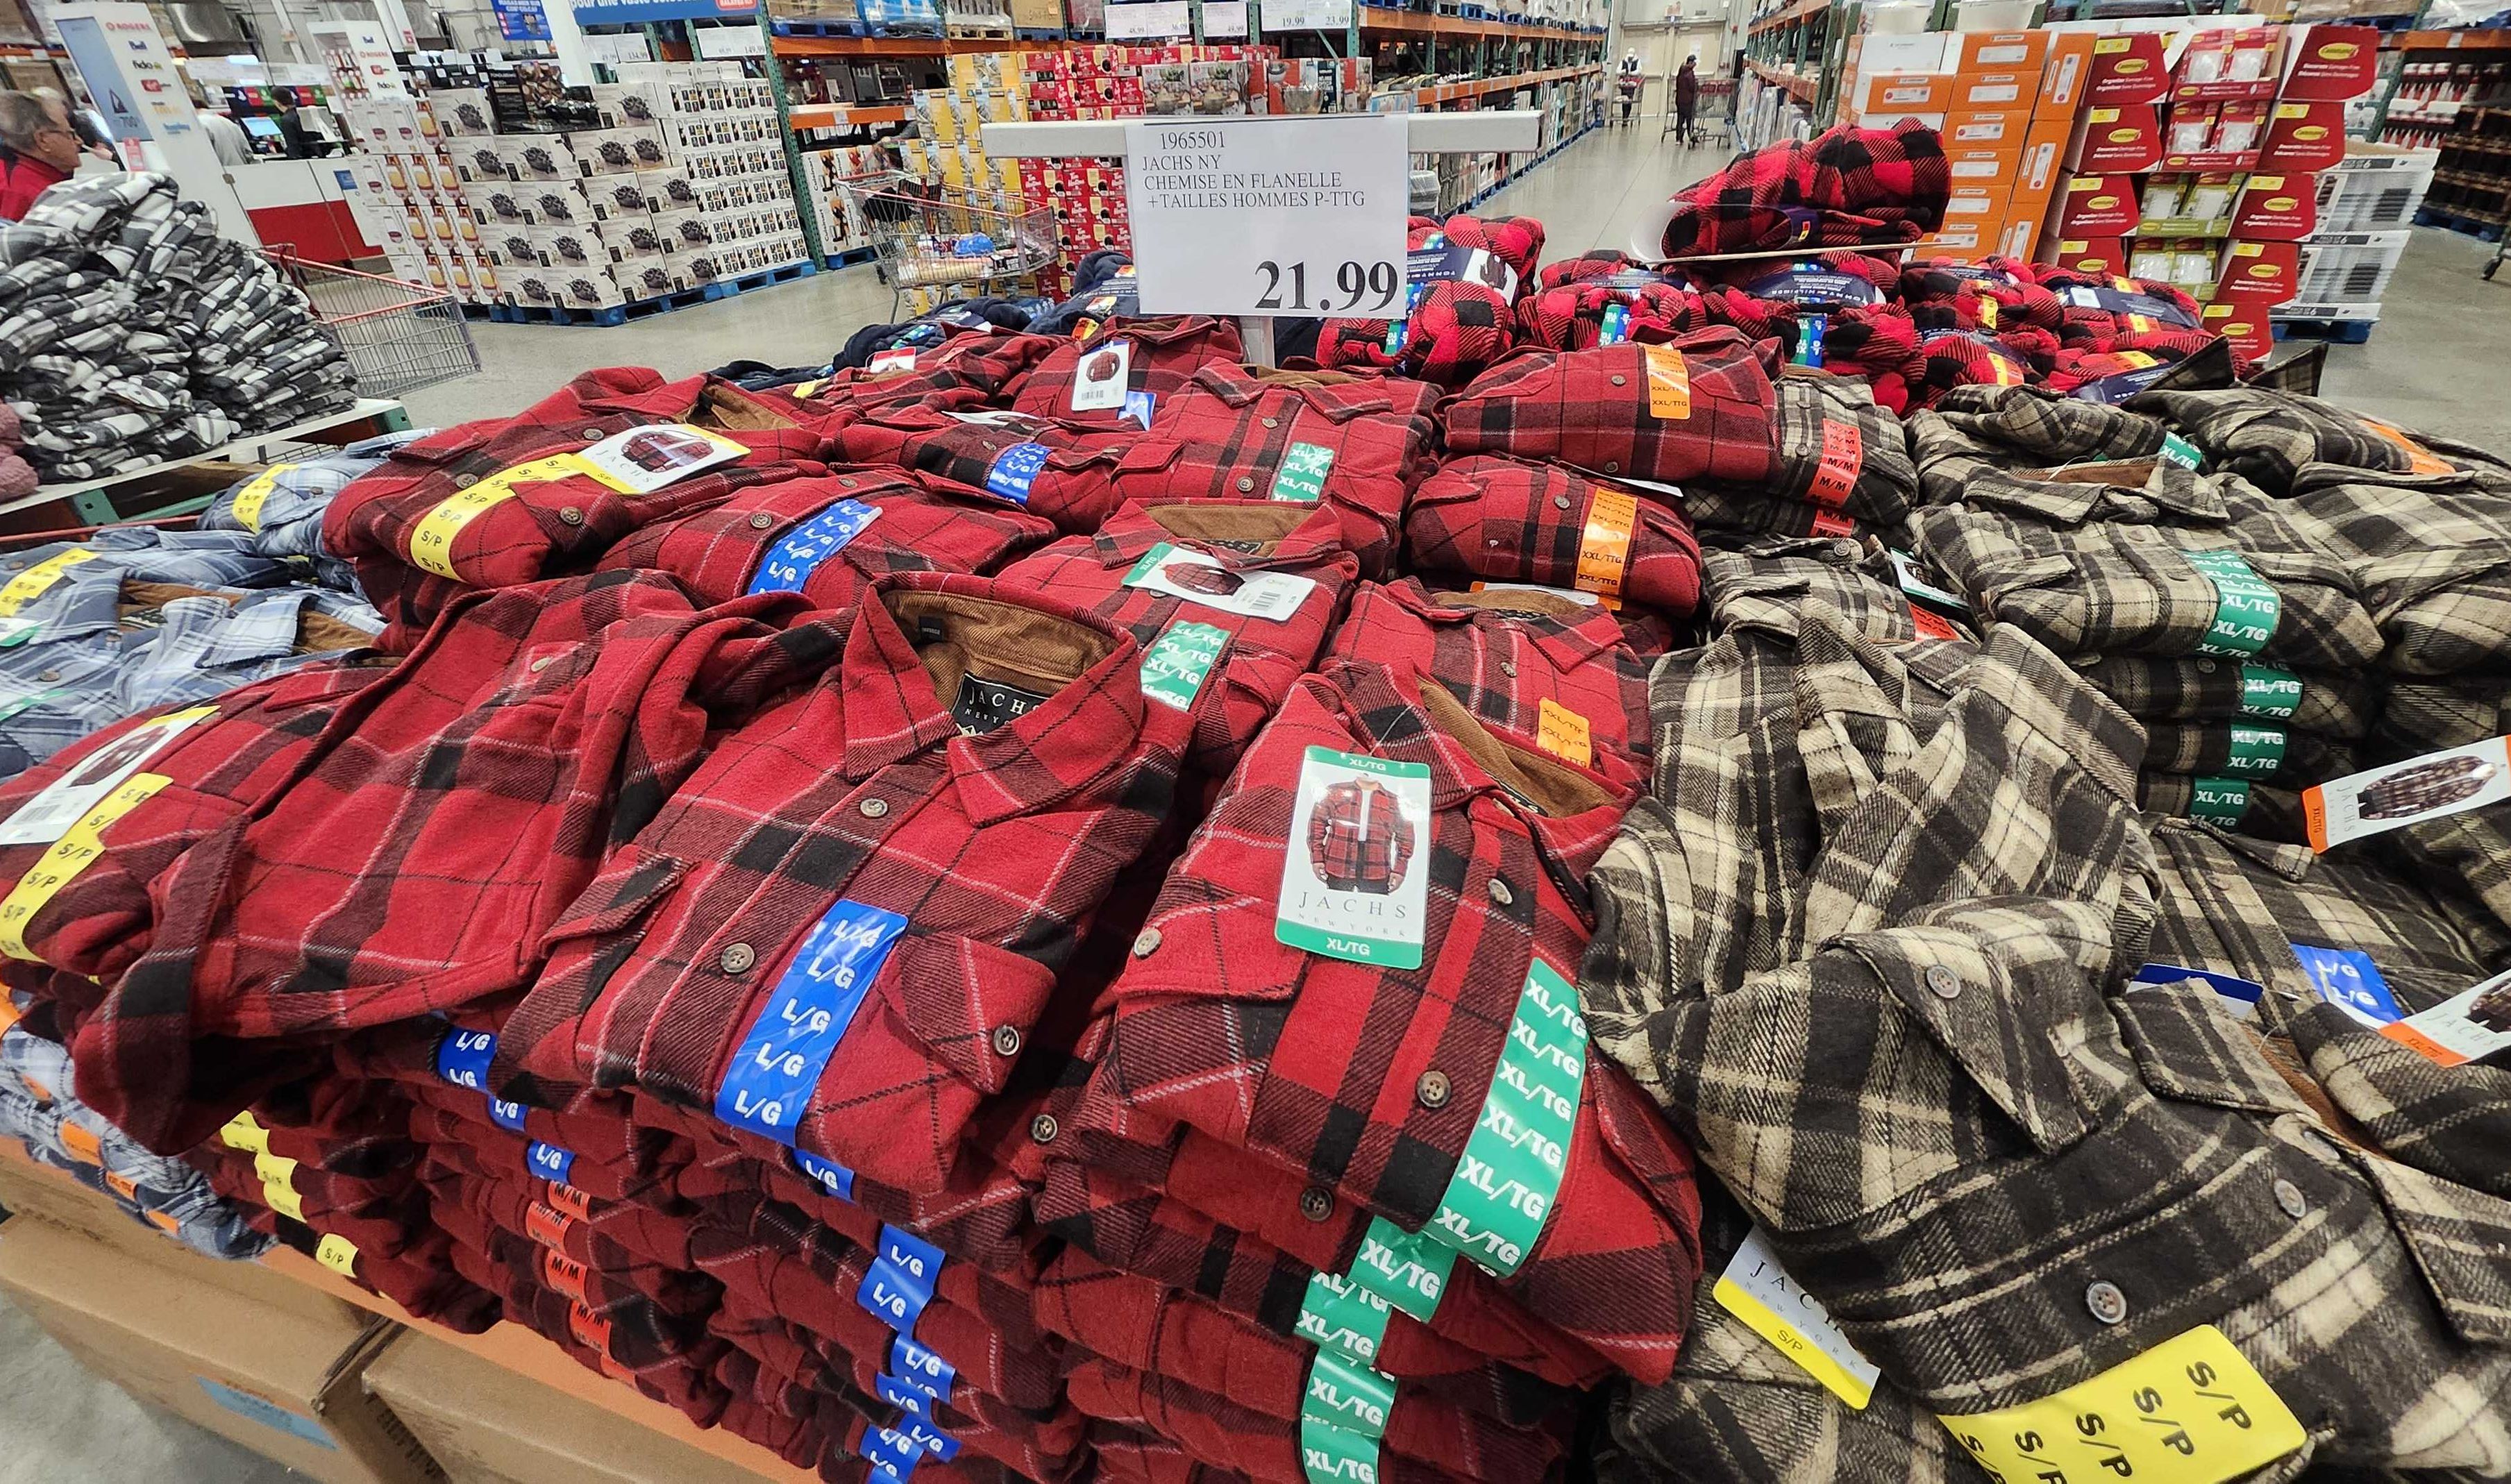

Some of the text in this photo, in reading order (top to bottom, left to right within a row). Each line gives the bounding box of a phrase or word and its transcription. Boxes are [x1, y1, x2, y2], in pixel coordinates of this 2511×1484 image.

[1282, 17, 1304, 27] 19.99
[1161, 131, 1225, 149] 1965501
[1143, 154, 1222, 171] JACHS NY
[1144, 172, 1342, 191] CHEMISE EN FLANELLE
[1148, 190, 1366, 208] +TAILLES HOMMES P-TTG
[1254, 260, 1398, 312] 21.99
[1827, 457, 1854, 472] M/M
[1277, 475, 1318, 496] XL/TG
[1819, 475, 1848, 491] M/M
[463, 491, 489, 505] S/P
[438, 507, 464, 523] S/P
[822, 515, 852, 534] L/G
[1593, 514, 1629, 528] XXL/TTG
[421, 530, 443, 548] S/P
[803, 528, 834, 546] L/G
[421, 556, 446, 572] S/P
[1582, 550, 1622, 564] XXL/TTG
[767, 561, 797, 582] L/G
[1577, 573, 1618, 586] XXL/TTG
[2222, 593, 2276, 614] XL/TG
[2212, 619, 2269, 641] XL/TG
[1157, 639, 1213, 664] XL/TG
[2195, 643, 2253, 658] XL/TG
[1145, 658, 1202, 685] XL/TG
[2244, 678, 2302, 695] XL/TG
[2237, 704, 2293, 718] XL/TG
[2231, 729, 2285, 746] XL/TG
[1348, 757, 1388, 772] XL/TG
[2227, 757, 2278, 770] XL/TG
[2195, 790, 2245, 805] XL/TG
[58, 843, 94, 860] S/P
[26, 871, 59, 888] S/P
[1298, 891, 1407, 919] JACHS
[833, 919, 880, 949] L/G
[1326, 936, 1371, 957] XL/TG
[806, 954, 856, 990] L/G
[781, 997, 832, 1034] L/G
[1525, 976, 1588, 1040] XL/TG
[455, 1031, 492, 1052] L/G
[1511, 1016, 1581, 1079] XL/TG
[755, 1042, 807, 1079] L/G
[449, 1068, 478, 1088] L/G
[1497, 1059, 1573, 1123] XL/TG
[494, 1099, 519, 1119] L/G
[733, 1088, 783, 1127] L/G
[1480, 1104, 1563, 1168] XL/TG
[535, 1143, 563, 1171] L/G
[805, 1159, 839, 1191] L/G
[554, 1181, 583, 1207] M/M
[1458, 1154, 1545, 1223] XL/TG
[1434, 1205, 1523, 1268] XL/TG
[324, 1247, 344, 1264] S/P
[891, 1244, 924, 1278] L/G
[551, 1256, 580, 1280] M/M
[1359, 1237, 1443, 1301] XL/TG
[873, 1281, 907, 1319] L/G
[1295, 1308, 1376, 1358] XL/TG
[1777, 1329, 1804, 1352] S/P
[905, 1346, 942, 1378] L/G
[888, 1388, 921, 1414] L/G
[1309, 1375, 1384, 1428] XL/TG
[2185, 1360, 2252, 1431] S/P
[2132, 1385, 2195, 1457] S/P
[879, 1427, 914, 1456] L/G
[910, 1424, 944, 1453] L/G
[2075, 1412, 2133, 1479] S/P
[869, 1449, 898, 1478] L/G
[1304, 1448, 1376, 1484] XL/TG
